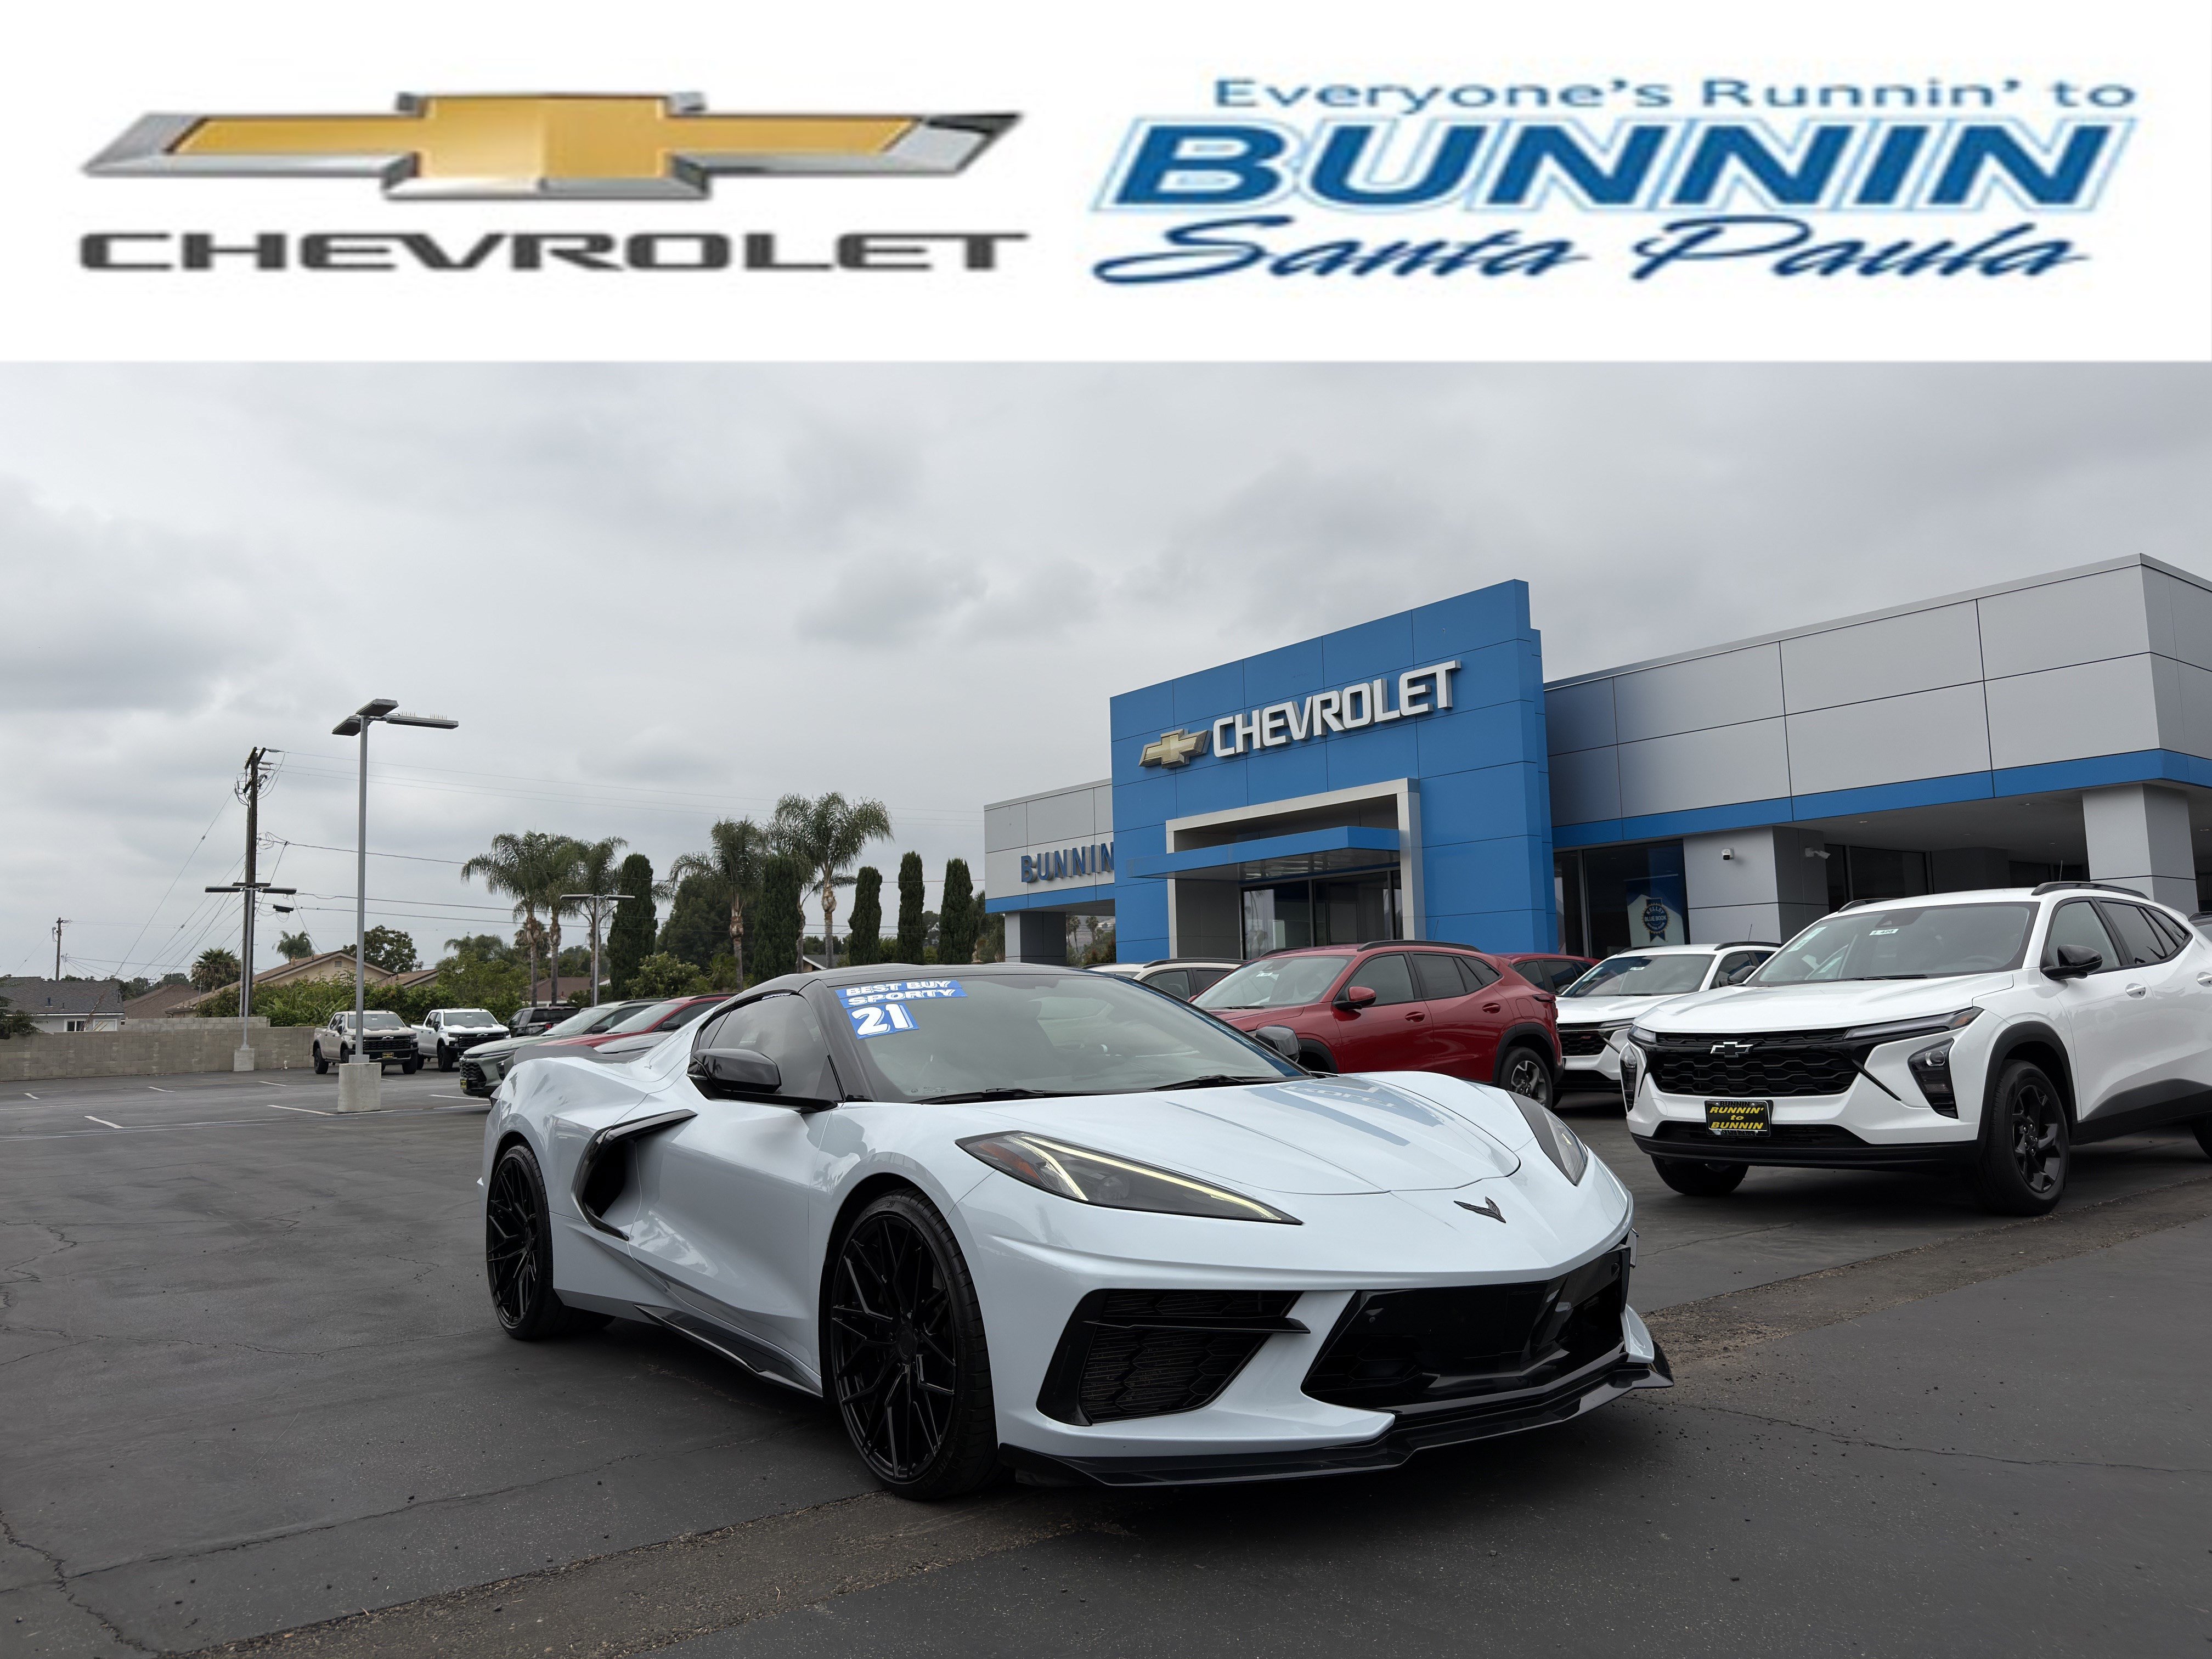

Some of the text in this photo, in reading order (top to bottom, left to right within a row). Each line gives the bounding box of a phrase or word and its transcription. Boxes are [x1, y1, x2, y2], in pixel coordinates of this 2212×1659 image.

[1213, 660, 1462, 758] CHEVROLET
[1021, 842, 1114, 883] BUNNIN
[1646, 906, 1665, 915] KELLEY
[846, 980, 951, 996] BEST BUY
[848, 989, 956, 1006] SPORTY
[851, 1003, 914, 1036] 21
